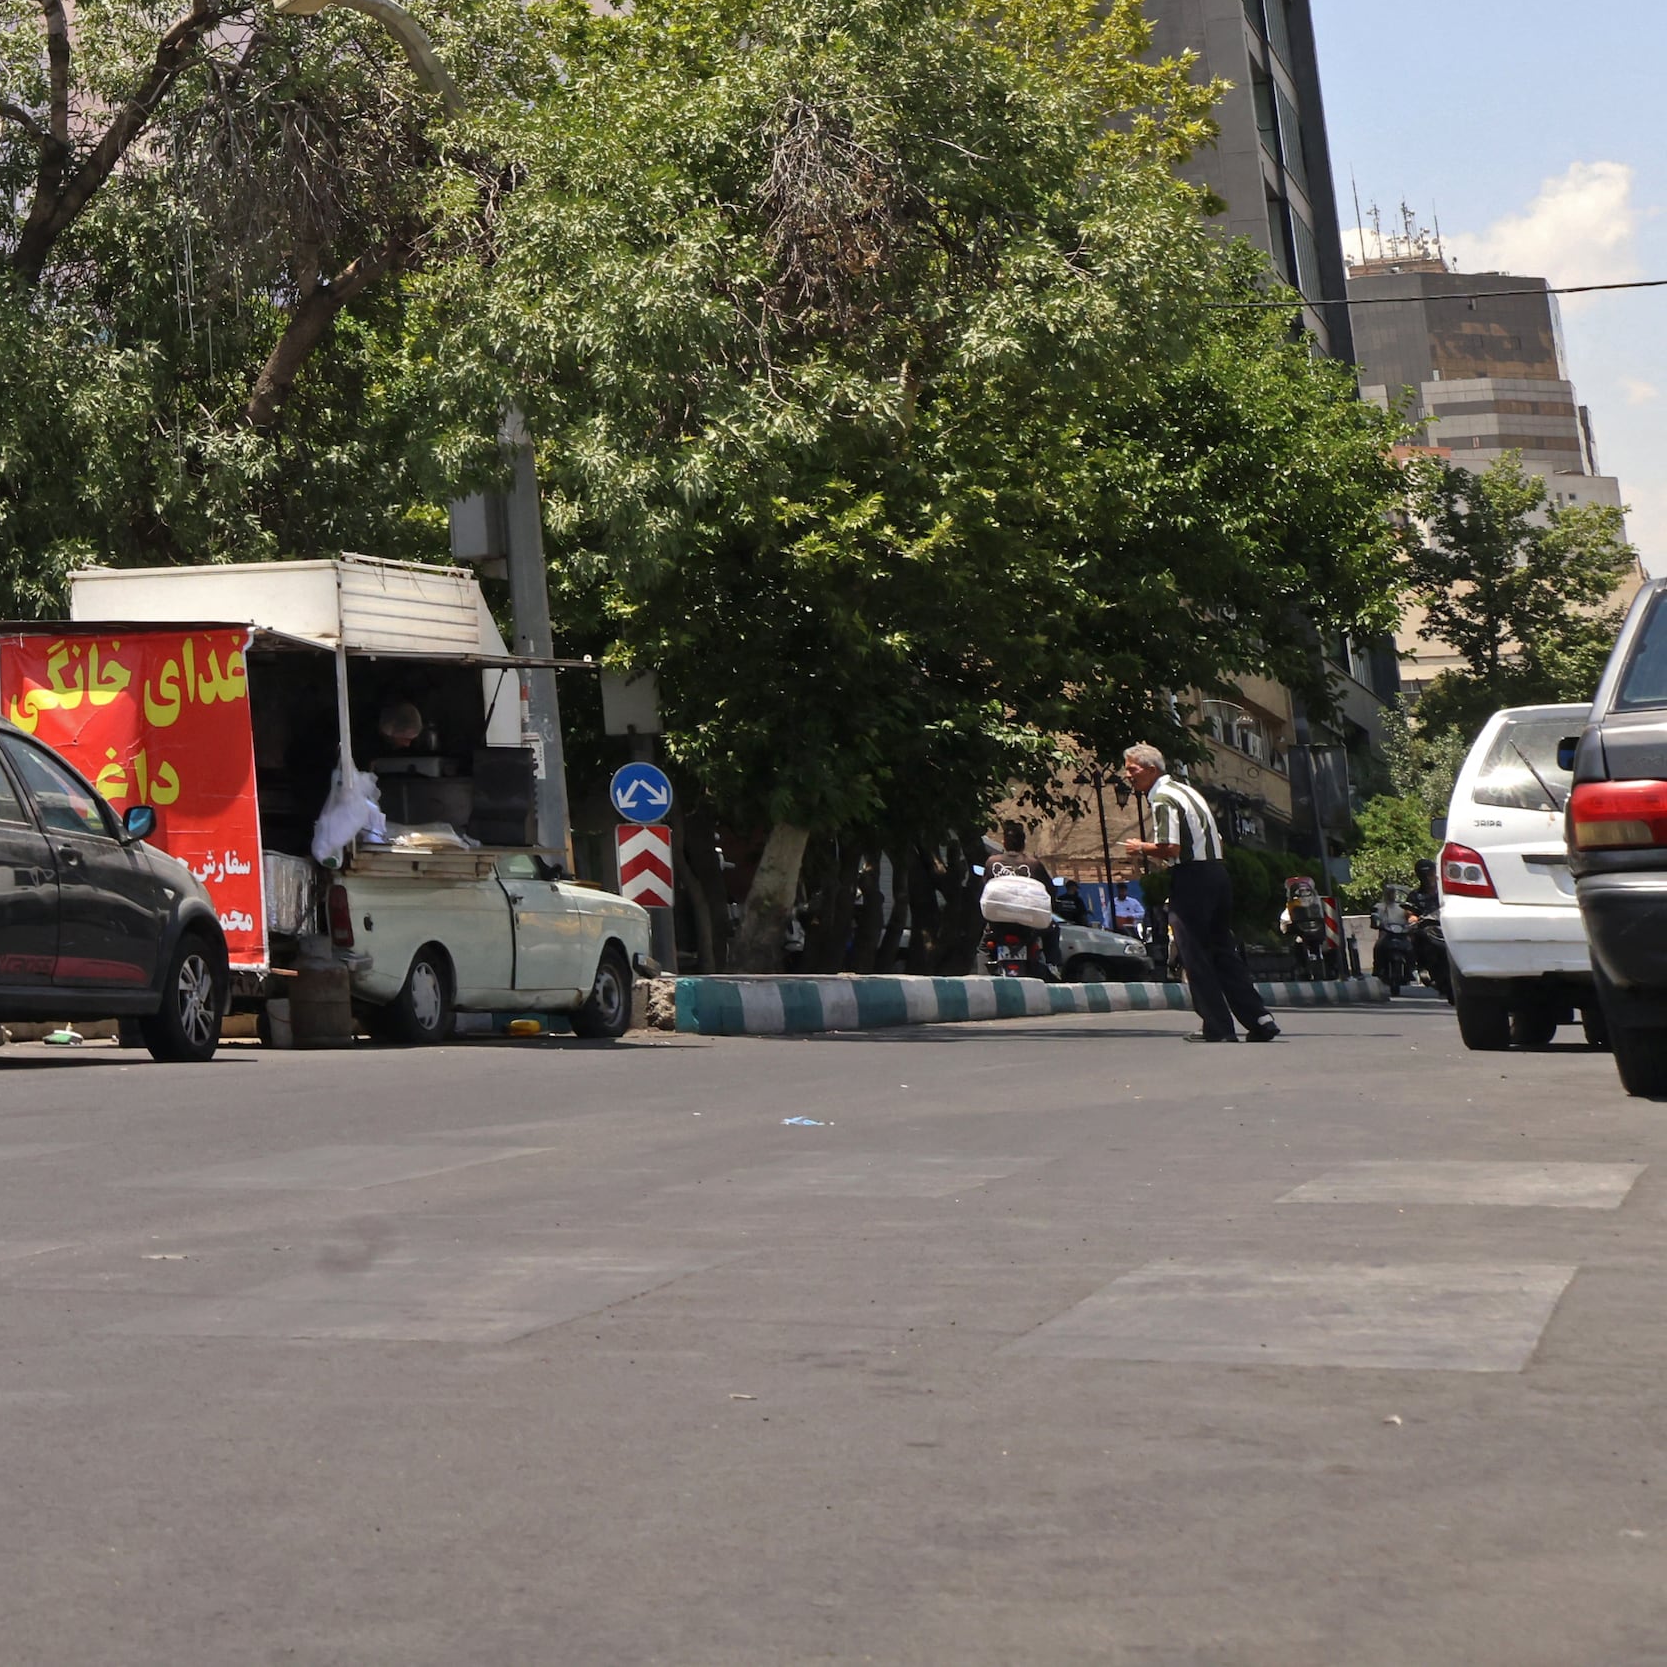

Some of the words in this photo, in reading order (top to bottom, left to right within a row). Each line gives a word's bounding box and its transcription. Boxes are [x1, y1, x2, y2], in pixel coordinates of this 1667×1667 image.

[10, 639, 132, 735] خانگی
[144, 634, 245, 727] غذای
[193, 850, 251, 882] سفارش
